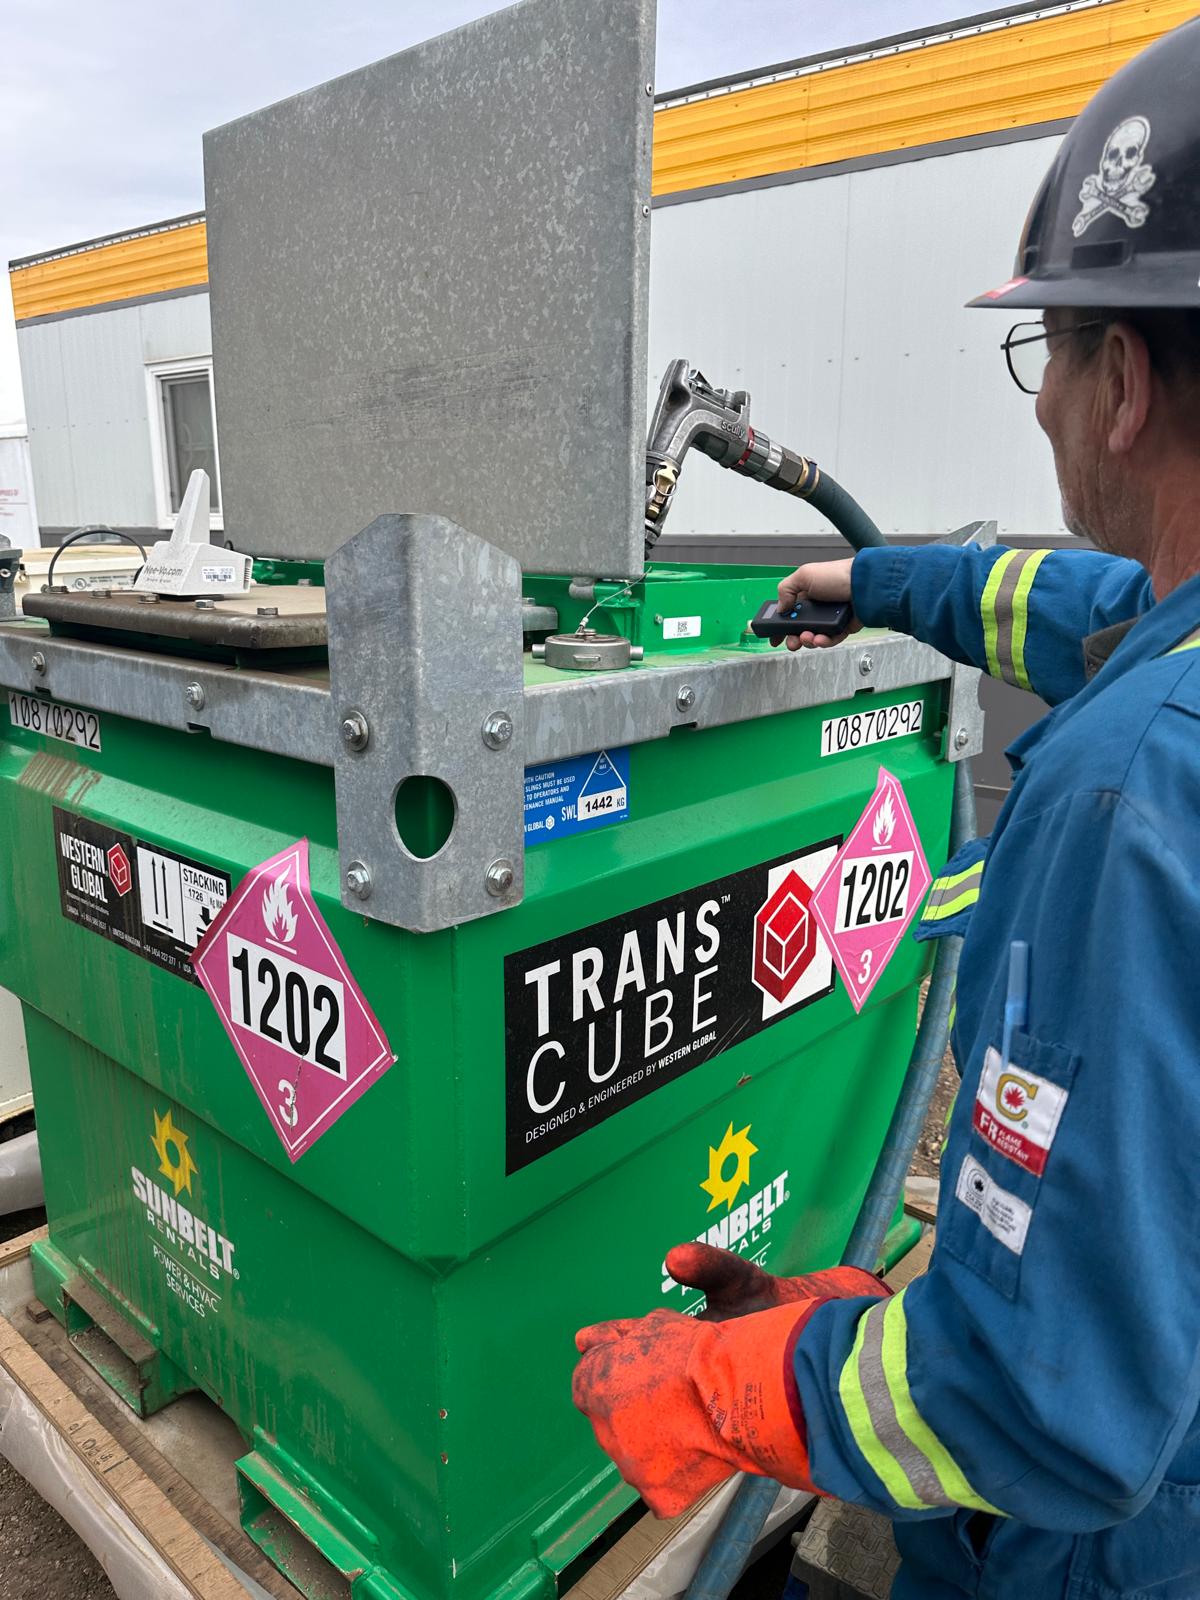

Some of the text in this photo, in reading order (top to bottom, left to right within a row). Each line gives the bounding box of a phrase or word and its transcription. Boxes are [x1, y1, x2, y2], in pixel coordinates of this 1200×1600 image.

[721, 421, 745, 439] scully
[11, 694, 99, 749] 10870292
[825, 702, 921, 752] 10870292
[525, 784, 542, 793] SLINGS
[542, 780, 556, 789] MUST
[564, 775, 576, 784] USED
[533, 788, 560, 799] OPERATORS
[560, 785, 570, 793] AND
[535, 772, 555, 782] CAUTION
[545, 795, 564, 806] MANUAL
[561, 804, 578, 822] SWL
[585, 795, 625, 812] 1442 KG
[528, 820, 544, 832] GLOBAL
[60, 832, 106, 874] WESTERN
[71, 864, 109, 904] GLOBAL
[183, 868, 224, 896] STACKING
[189, 888, 204, 903] 1726
[843, 859, 909, 928] 1202
[525, 899, 720, 1038] TRANS
[858, 949, 873, 985] 3
[232, 947, 341, 1074] 1202
[526, 965, 719, 1114] CUBE
[278, 1079, 298, 1127] 3
[525, 1031, 717, 1144] DESIGNED & ENGINEERED BY WESTERN GLOBAL
[980, 1111, 999, 1140] FR
[998, 1129, 1022, 1149] FLAME
[131, 1166, 235, 1275] SUNBELT
[147, 1209, 220, 1280] RENTALS
[153, 1245, 218, 1312] POWER & HVAC
[166, 1273, 205, 1317] SERVICES
